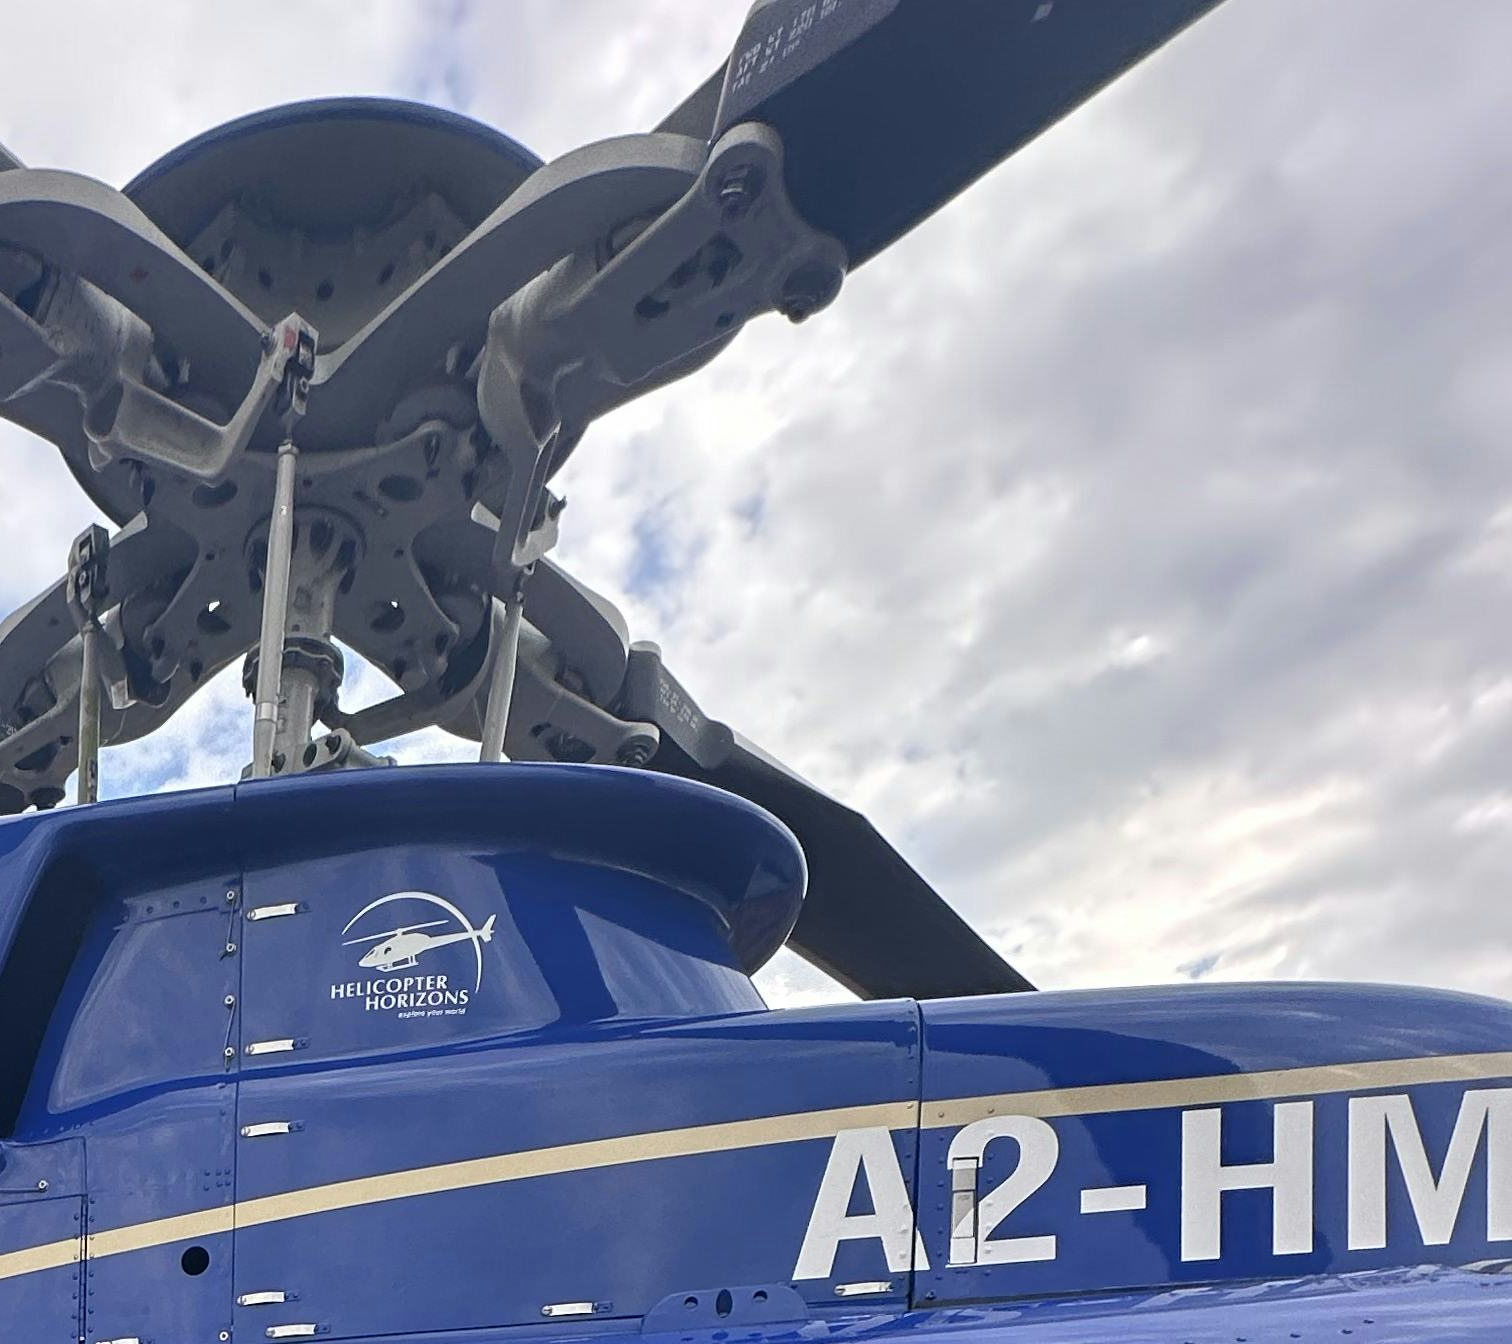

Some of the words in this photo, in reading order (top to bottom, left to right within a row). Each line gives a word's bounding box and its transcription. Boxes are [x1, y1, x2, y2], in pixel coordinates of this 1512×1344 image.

[331, 975, 447, 999] HELICOPTER
[365, 989, 468, 1011] HORIZONS
[792, 1088, 1512, 1281] A2-HM
